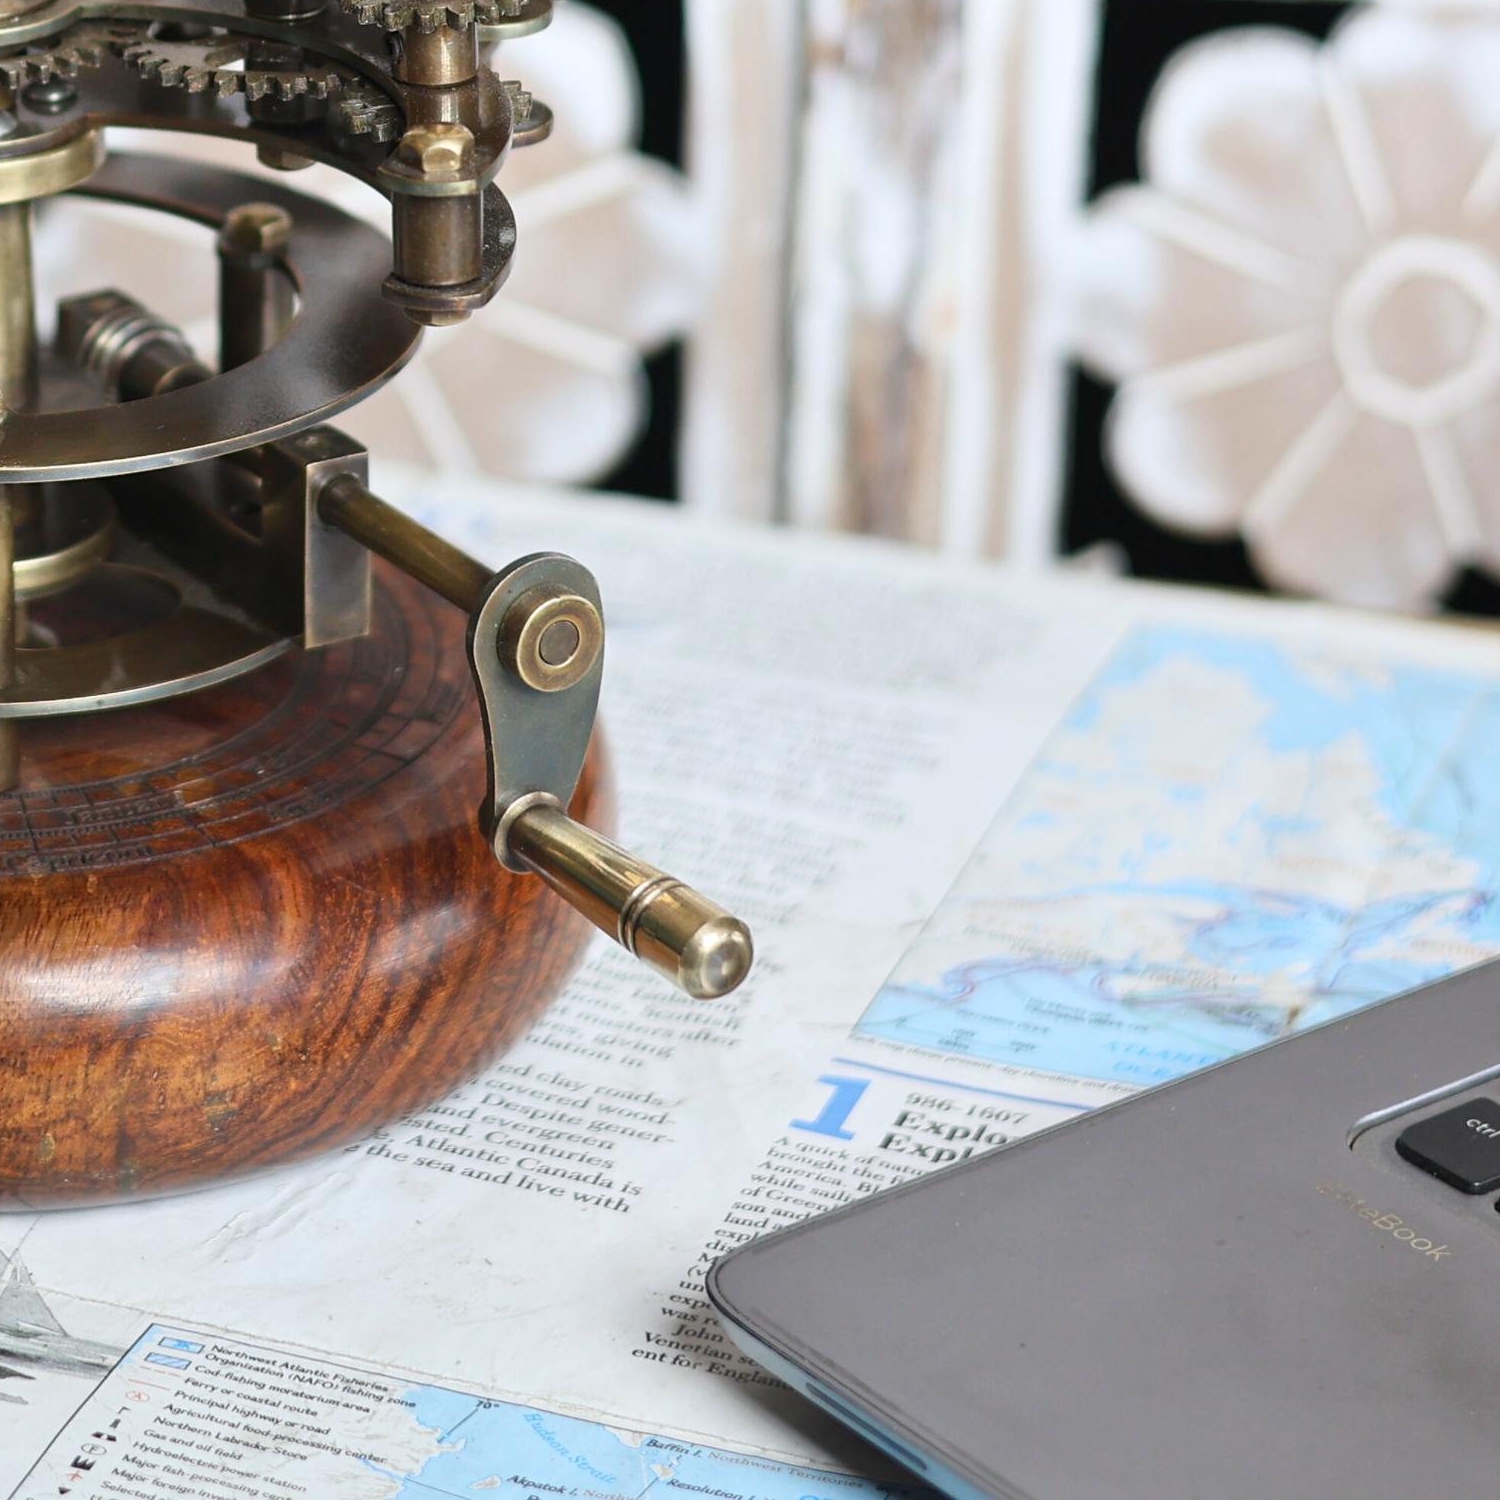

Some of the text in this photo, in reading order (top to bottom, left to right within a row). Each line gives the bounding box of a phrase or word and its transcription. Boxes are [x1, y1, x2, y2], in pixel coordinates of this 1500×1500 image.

[788, 1074, 872, 1141] 1
[905, 1091, 1031, 1124] 986-1607
[481, 1113, 615, 1150] evergreen
[484, 1130, 615, 1170] Centuries
[366, 1144, 631, 1214] the sea and live with
[406, 1134, 644, 1197] Atlantic Canada is
[750, 1173, 806, 1191] while
[723, 1212, 769, 1229] land
[732, 1201, 765, 1213] son
[672, 1324, 725, 1343] John
[205, 1353, 417, 1409] Organization (NAFO) fishing zone
[211, 1344, 388, 1392] Northwest Atlantic Fisheries
[631, 1348, 702, 1370] ent for
[184, 1377, 319, 1417] Ferry or coastal route
[194, 1365, 371, 1414] Cod-fishing moratorium area
[163, 1404, 387, 1463] Agricultural food-processing center
[175, 1390, 332, 1435] Principal highway or road
[143, 1428, 244, 1460] Gas and oil field
[153, 1416, 308, 1461] Northern Labrador Store
[523, 1411, 618, 1485] Hudson Strait
[122, 1454, 260, 1497] Major fish-processing
[133, 1441, 307, 1493] Hydroelectric power station
[507, 1474, 572, 1494] Akpatok
[646, 1438, 690, 1455] Baffin
[707, 1451, 782, 1473] Northwest
[787, 1467, 864, 1489] Territories
